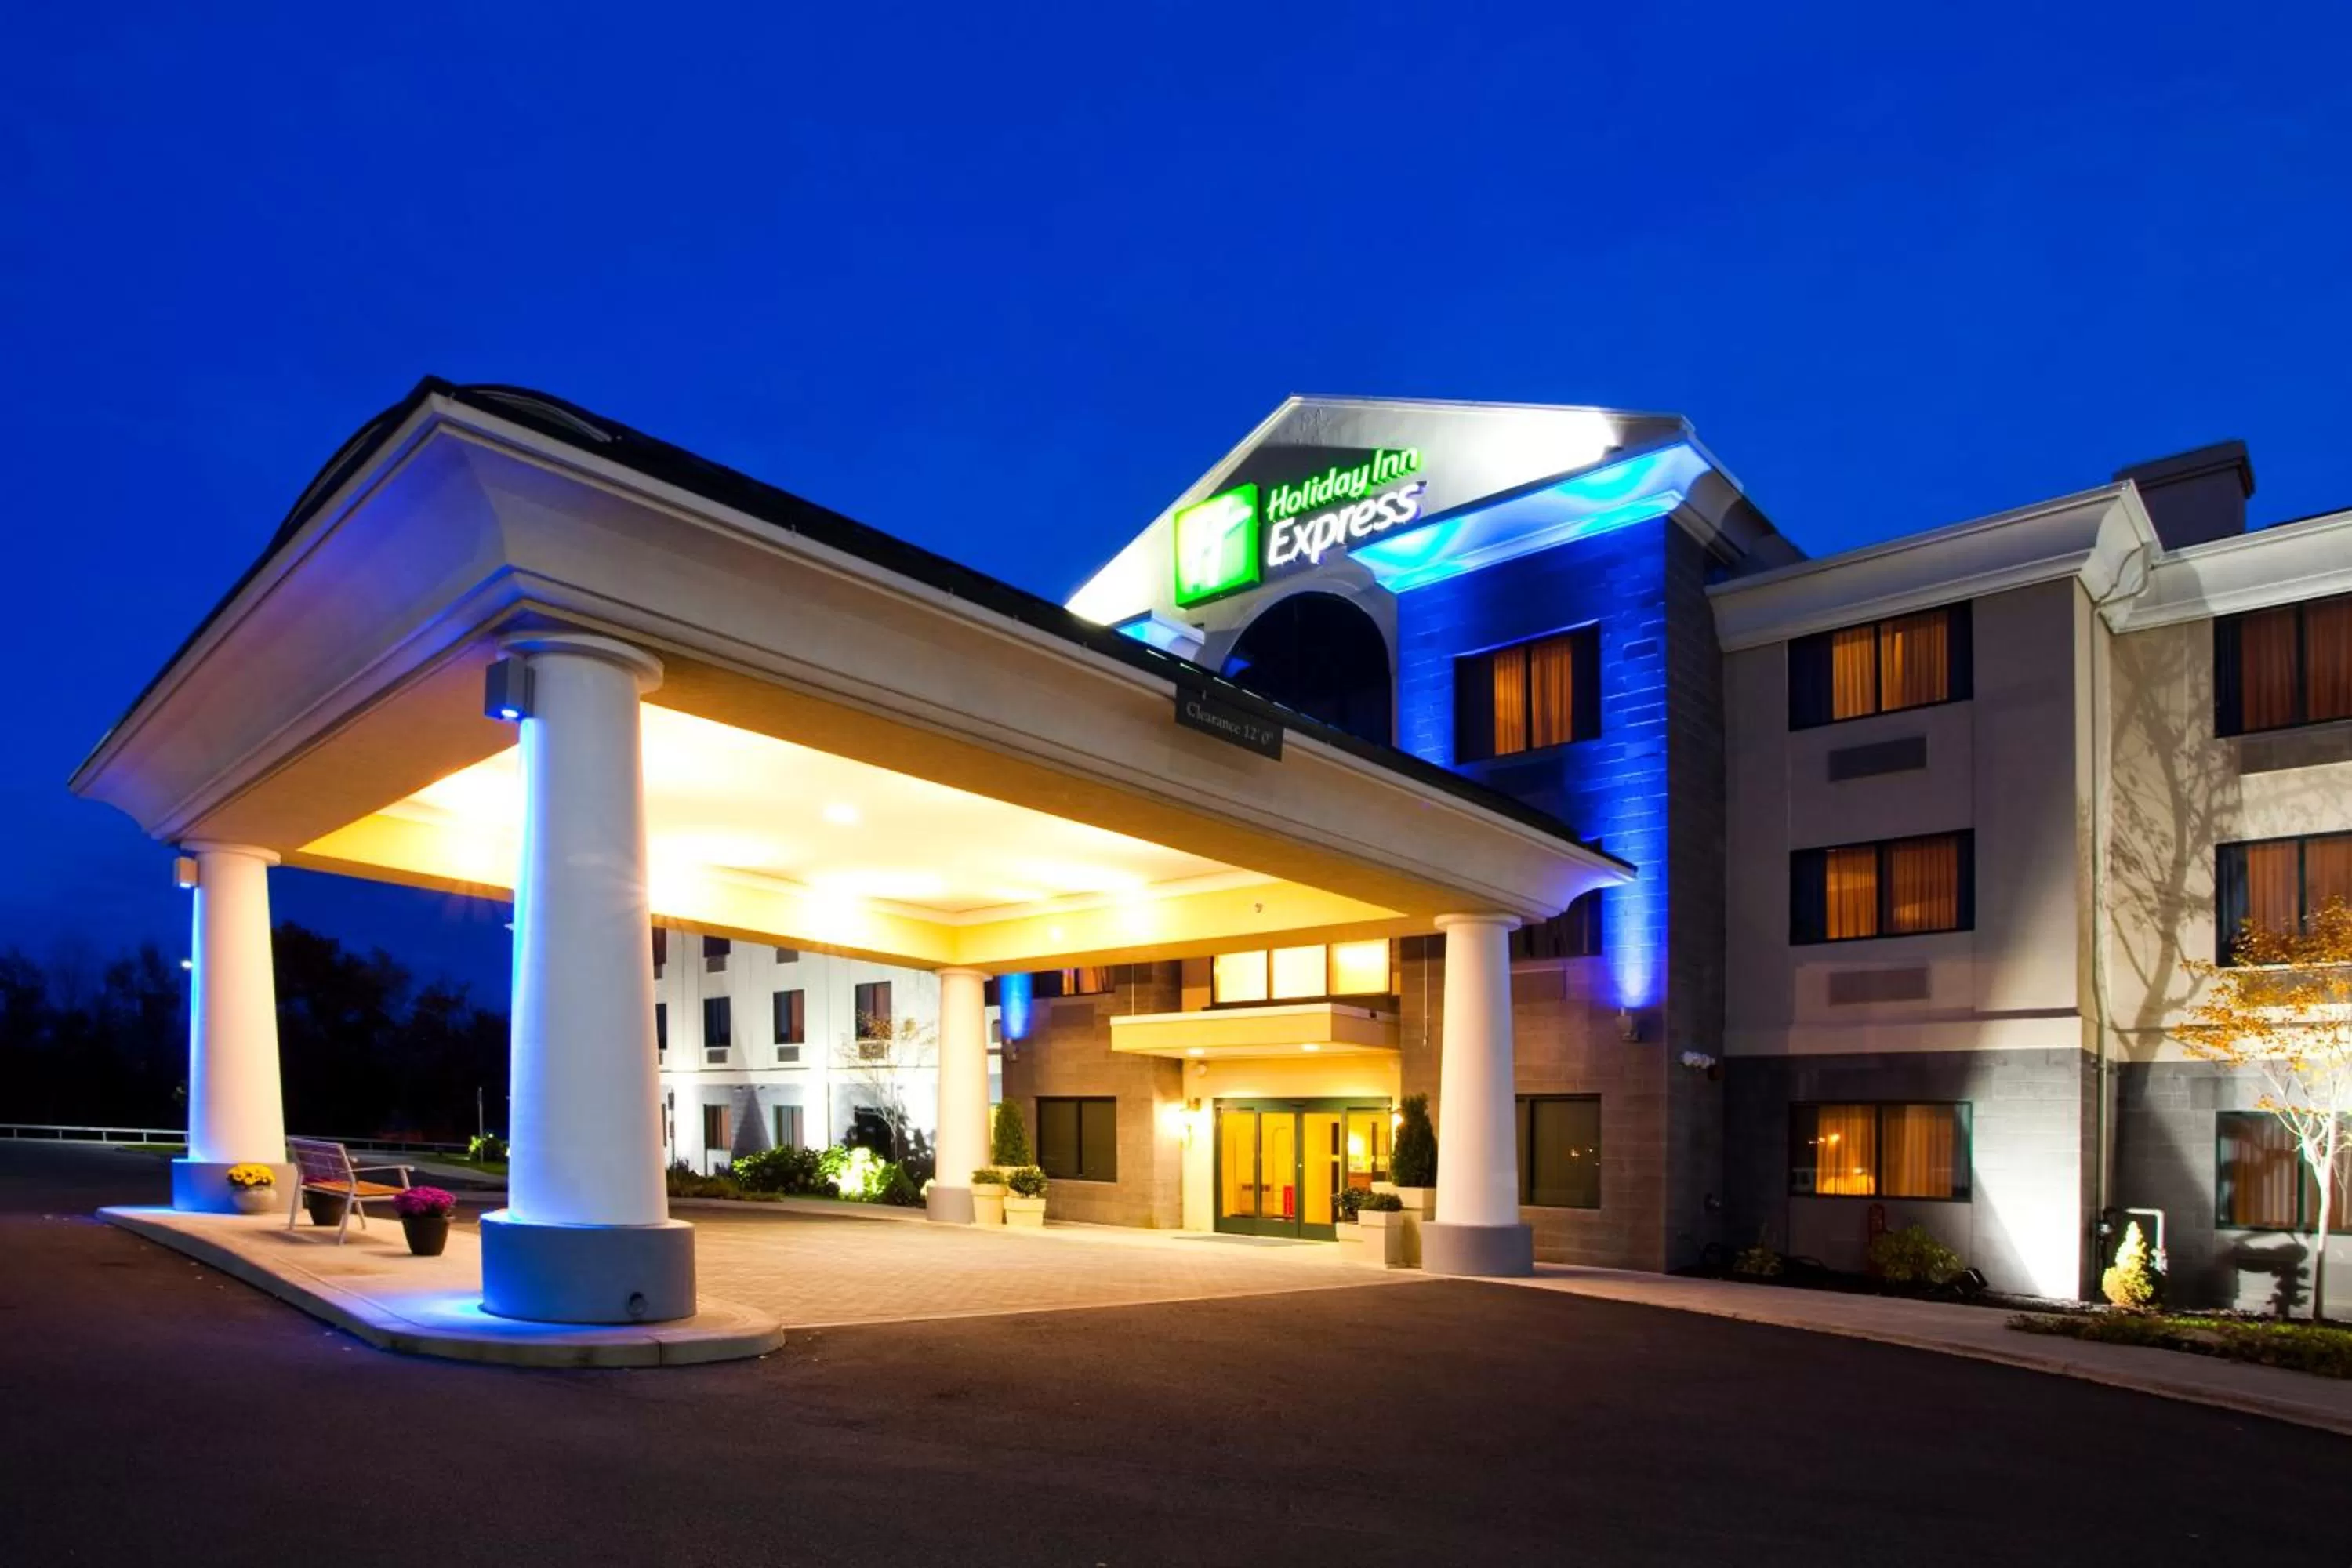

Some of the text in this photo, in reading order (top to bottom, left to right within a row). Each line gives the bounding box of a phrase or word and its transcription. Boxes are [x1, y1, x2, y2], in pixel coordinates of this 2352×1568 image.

[1267, 448, 1421, 522] Holiday Inn
[1267, 485, 1421, 566] Express
[1186, 702, 1241, 735] Clearance
